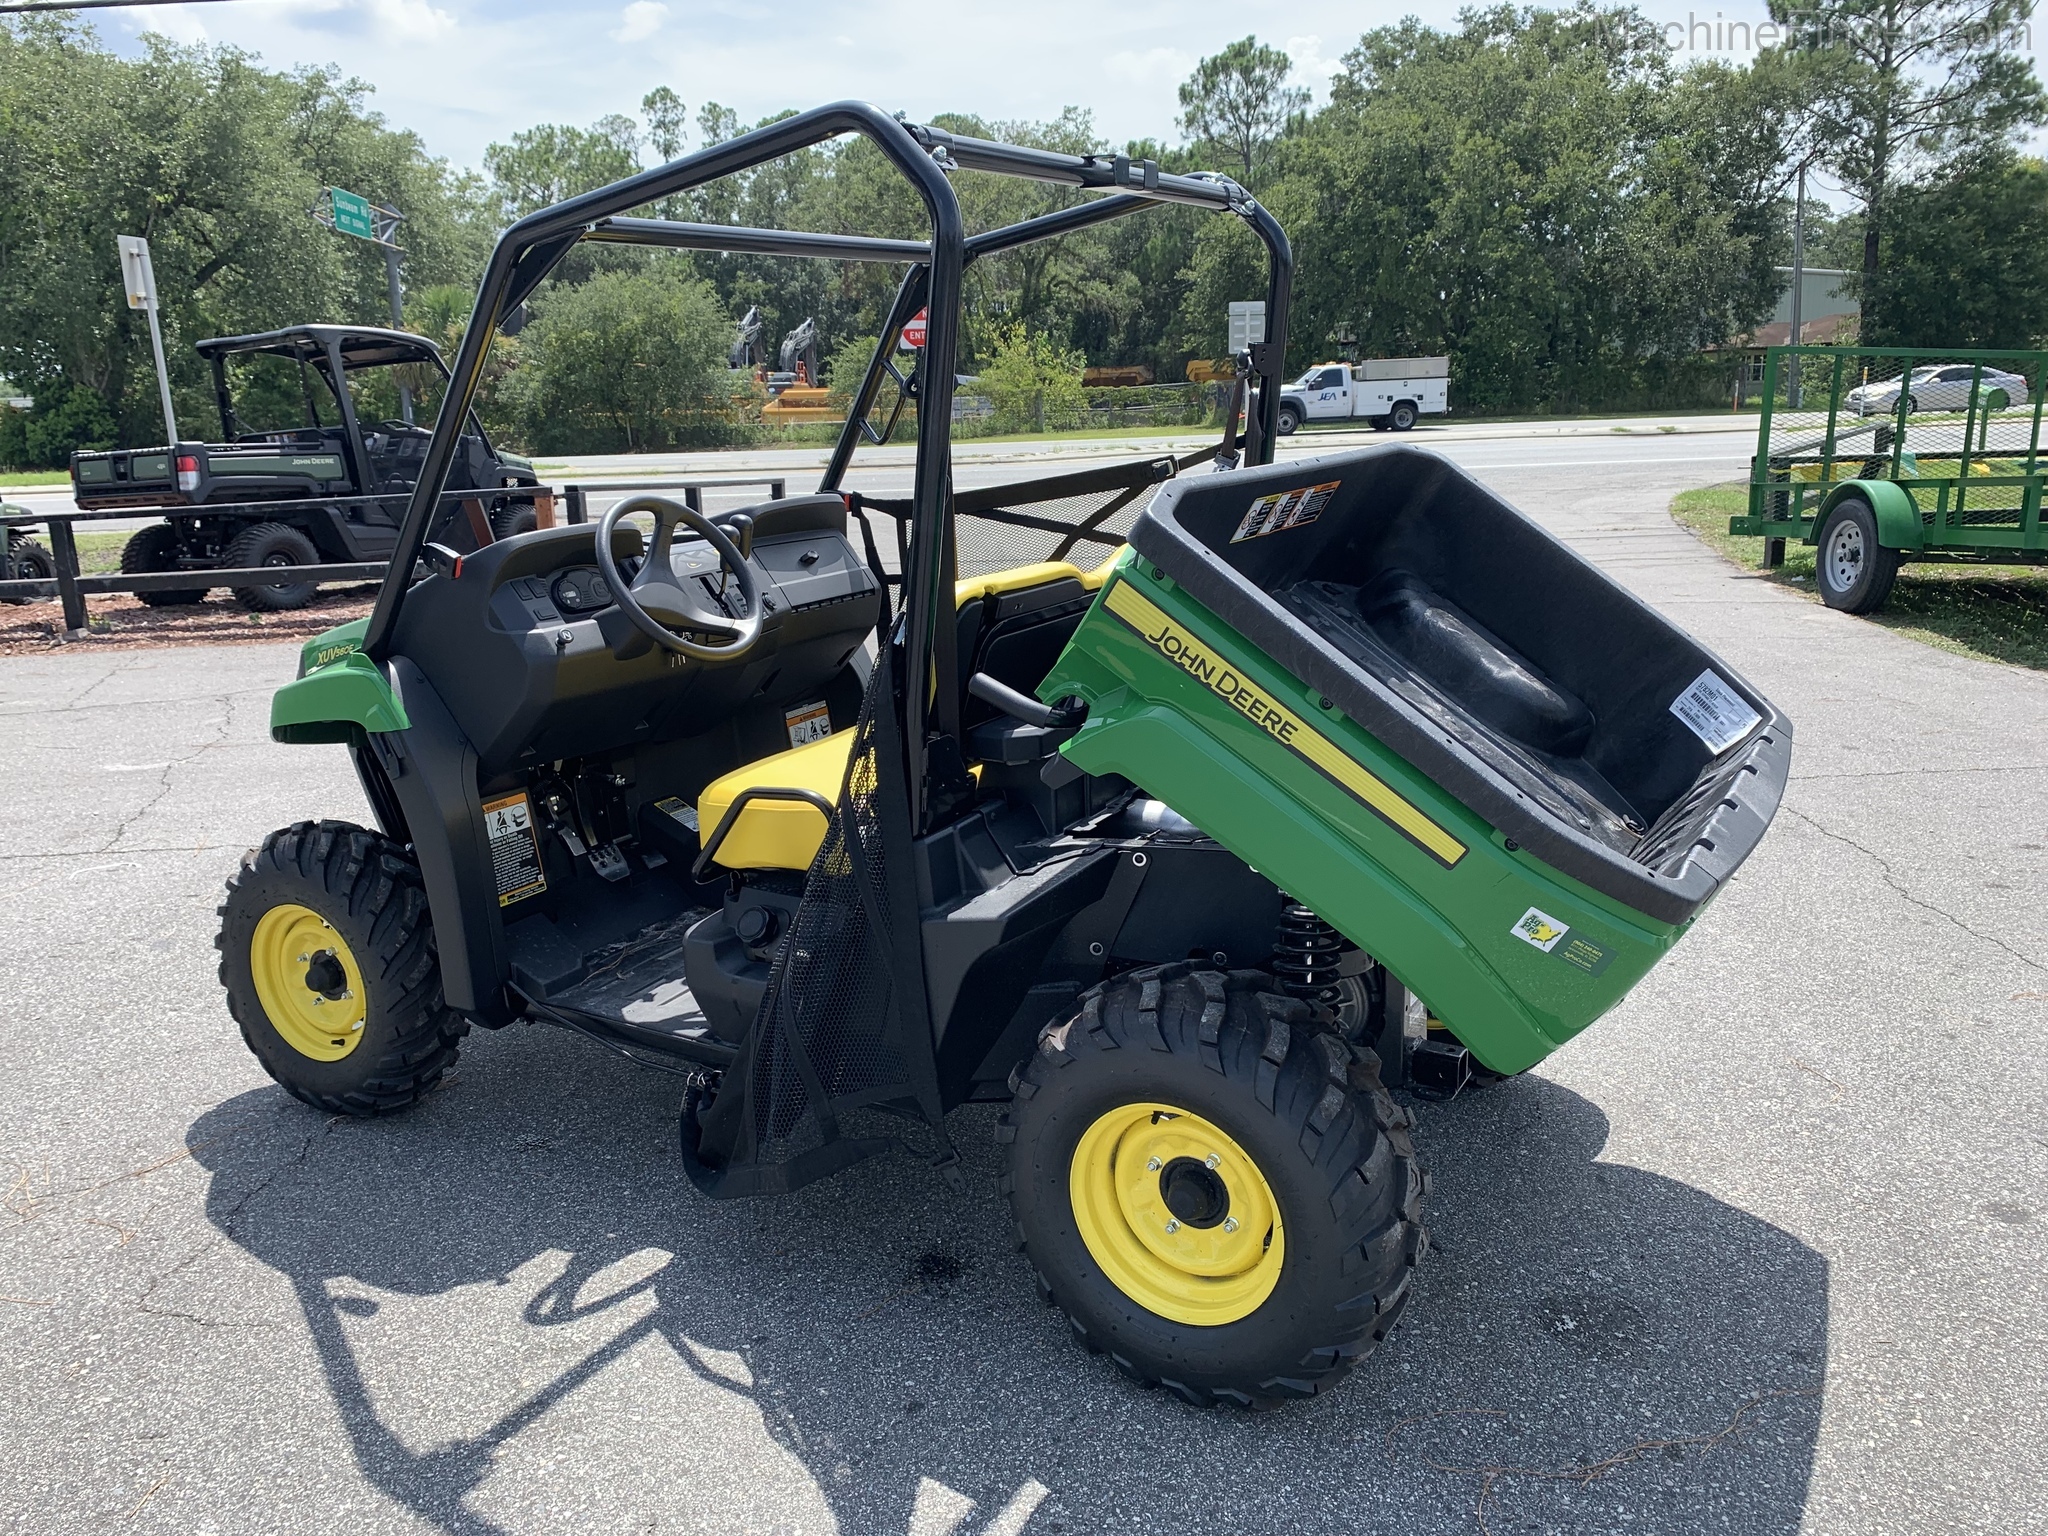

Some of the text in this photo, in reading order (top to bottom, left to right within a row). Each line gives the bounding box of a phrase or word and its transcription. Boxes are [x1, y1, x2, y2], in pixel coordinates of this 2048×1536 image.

[909, 331, 926, 340] ENT
[1317, 392, 1337, 401] JEA
[311, 457, 335, 465] DEERE
[1148, 626, 1299, 743] JOHN DEERE
